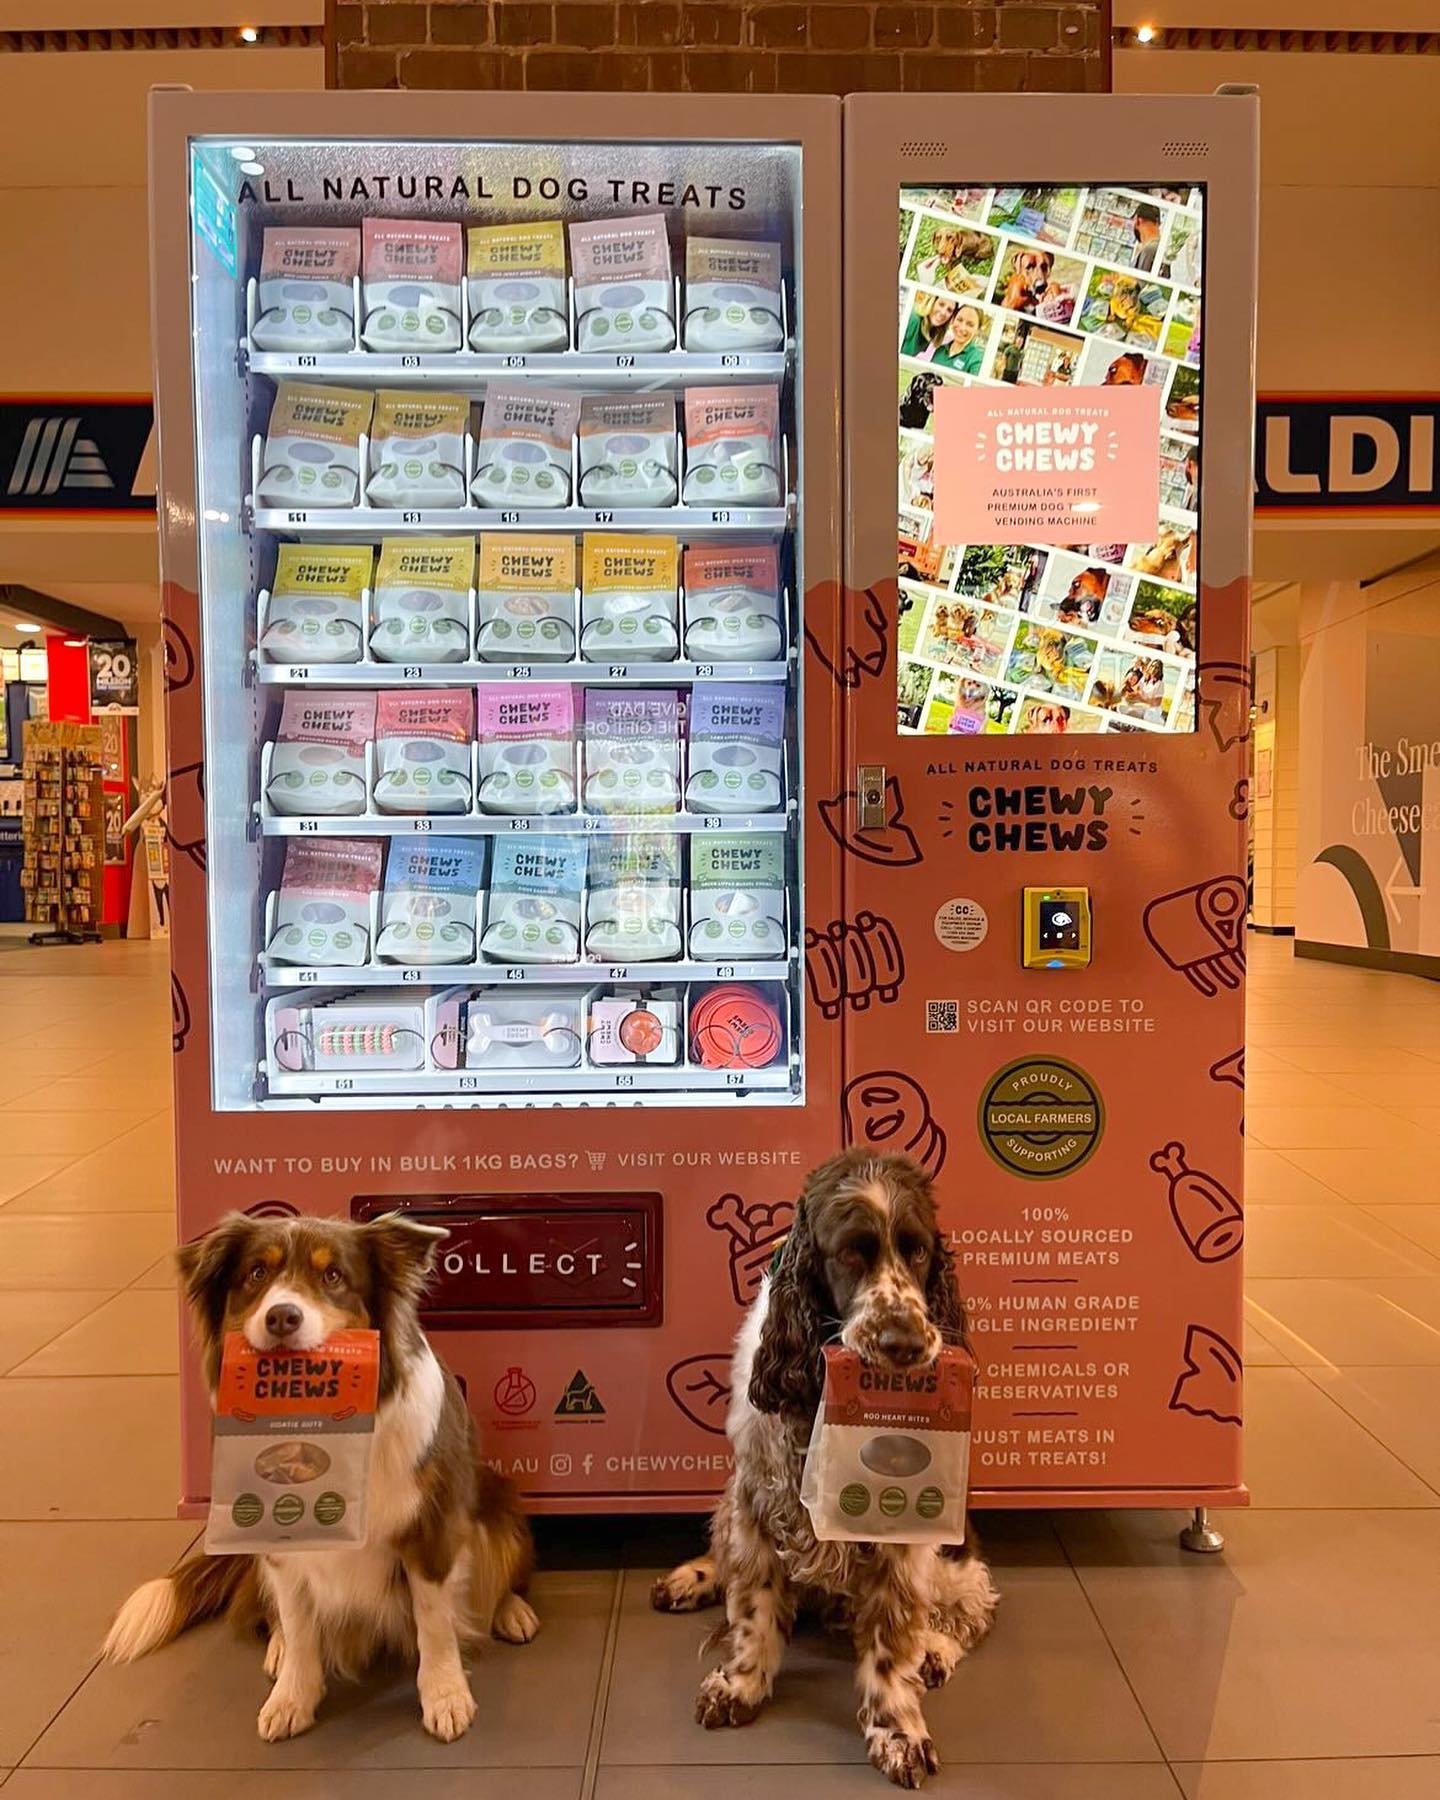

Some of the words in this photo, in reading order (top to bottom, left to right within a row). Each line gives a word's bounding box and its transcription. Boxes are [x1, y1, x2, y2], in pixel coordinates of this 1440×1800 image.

[238, 178, 304, 204] ALL
[323, 176, 494, 201] NATURAL
[513, 177, 588, 201] DOG
[608, 179, 747, 211] TREATS
[384, 242, 438, 254] CHEWY
[490, 244, 542, 255] CHEWY
[592, 240, 644, 254] CHEWY
[384, 254, 437, 264] CHEWS
[490, 252, 541, 263] CHEWS
[593, 254, 644, 266] CHEWS
[300, 357, 315, 366] 01
[404, 357, 419, 366] 03
[509, 357, 524, 366] 05
[618, 357, 633, 366] 07
[723, 356, 738, 365] 09
[295, 404, 349, 417] CHEWY
[505, 404, 558, 415] CHEWY
[987, 409, 1004, 417] ALL
[1008, 408, 1049, 416] NATURAL
[1052, 408, 1071, 416] DOG
[1075, 408, 1109, 417] TREATS
[292, 412, 345, 426] CHEWS
[504, 412, 556, 427] CHEWS
[705, 410, 755, 425] CHEWS
[996, 421, 1099, 445] CHEWY
[996, 447, 1095, 472] CHEWS
[1254, 415, 1434, 493] LDI
[992, 488, 1064, 497] AUSTRALIA'S
[1067, 488, 1098, 497] FIRST
[987, 503, 1037, 511] PREMIUM
[1040, 503, 1065, 511] DOG
[405, 514, 420, 522] 13
[597, 513, 612, 522] 17
[714, 513, 728, 522] 19
[995, 517, 1045, 526] VENDING
[1047, 517, 1098, 526] MACHINE
[401, 555, 454, 565] CHEWY
[502, 555, 554, 566] CHEWY
[604, 557, 655, 568] CHEWY
[298, 565, 350, 575] CHEWY
[400, 564, 450, 573] CHEWS
[501, 567, 552, 577] CHEWS
[604, 566, 654, 577] CHEWS
[295, 574, 347, 583] CHEWS
[98, 654, 131, 678] 20
[611, 667, 626, 676] 27
[697, 666, 712, 675] 29
[292, 669, 307, 677] 21
[406, 668, 420, 677] 23
[515, 667, 530, 677] 25
[400, 708, 452, 717] CHEWY
[499, 702, 551, 714] CHEWY
[712, 705, 762, 715] CHEWY
[303, 710, 354, 720] CHEWY
[398, 714, 449, 724] CHEWS
[499, 712, 549, 724] CHEWS
[711, 715, 761, 726] CHEWS
[301, 721, 352, 731] CHEWS
[1355, 742, 1391, 781] The
[926, 763, 957, 775] ALL
[964, 760, 1042, 773] NATURAL
[1050, 760, 1086, 770] DOG
[1094, 760, 1158, 773] TREATS
[968, 785, 1113, 818] CHEWY
[106, 811, 121, 832] 20
[301, 822, 316, 830] 31
[416, 820, 430, 830] 33
[585, 819, 598, 828] 37
[706, 819, 720, 828] 39
[968, 820, 1109, 852] CHEWS
[711, 849, 762, 859] CHEWY
[410, 855, 462, 866] CHEWY
[516, 854, 567, 867] CHEWY
[711, 859, 761, 870] CHEWS
[408, 865, 459, 877] CHEWS
[514, 866, 564, 878] CHEWS
[955, 905, 969, 915] CC
[404, 971, 420, 980] 43
[508, 970, 523, 979] 45
[611, 969, 626, 978] 47
[718, 968, 733, 977] 49
[967, 1000, 1018, 1014] SCAN
[1025, 1000, 1053, 1014] QR
[1059, 1000, 1112, 1013] CODE
[1119, 1000, 1144, 1013] TO
[967, 1019, 1016, 1033] VISIT
[1023, 1019, 1063, 1033] OUR
[1069, 1018, 1156, 1033] WEBSITE
[1011, 1073, 1074, 1092] PROUDLY
[991, 1113, 1031, 1124] LOCAL
[1034, 1113, 1092, 1124] FARMERS
[1006, 1137, 1078, 1162] SUPPORTING
[214, 1158, 277, 1174] WANT
[284, 1158, 312, 1173] TO
[321, 1157, 362, 1173] BUY
[370, 1156, 392, 1172] IN
[400, 1155, 457, 1172] BULK
[462, 1155, 503, 1170] 1KG
[510, 1154, 579, 1170] BAGS?
[618, 1153, 666, 1167] VISIT
[672, 1152, 712, 1166] OUR
[718, 1151, 801, 1165] WEBSITE
[1021, 1207, 1069, 1222] 100%
[951, 1230, 1035, 1244] LOCALLY
[1041, 1229, 1133, 1243] SOURCED
[421, 1253, 603, 1274] OLLECT
[963, 1252, 1050, 1265] PREMIUM
[1057, 1251, 1120, 1265] MEATS
[966, 1297, 992, 1310] 0%
[999, 1297, 1067, 1310] HUMAN
[1074, 1296, 1140, 1309] GRADE
[968, 1318, 1014, 1332] NGLE
[1021, 1317, 1139, 1332] INGREDIENT
[256, 1358, 343, 1376] CHEWY
[987, 1363, 1096, 1377] CHEMICALS
[1103, 1362, 1130, 1376] OR
[858, 1371, 938, 1393] CHEWS
[254, 1379, 339, 1399] CHEWS
[972, 1384, 1119, 1399] RESERVATIVES
[863, 1412, 881, 1420] ROO
[881, 1413, 906, 1422] HEART
[908, 1414, 930, 1423] BITES
[973, 1430, 1021, 1444] JUST
[1027, 1429, 1089, 1443] MEATS
[1096, 1429, 1115, 1442] IN
[606, 1455, 736, 1472] CHEWYCHEW
[981, 1452, 1021, 1466] OUR
[1028, 1451, 1107, 1466] TREATS!
